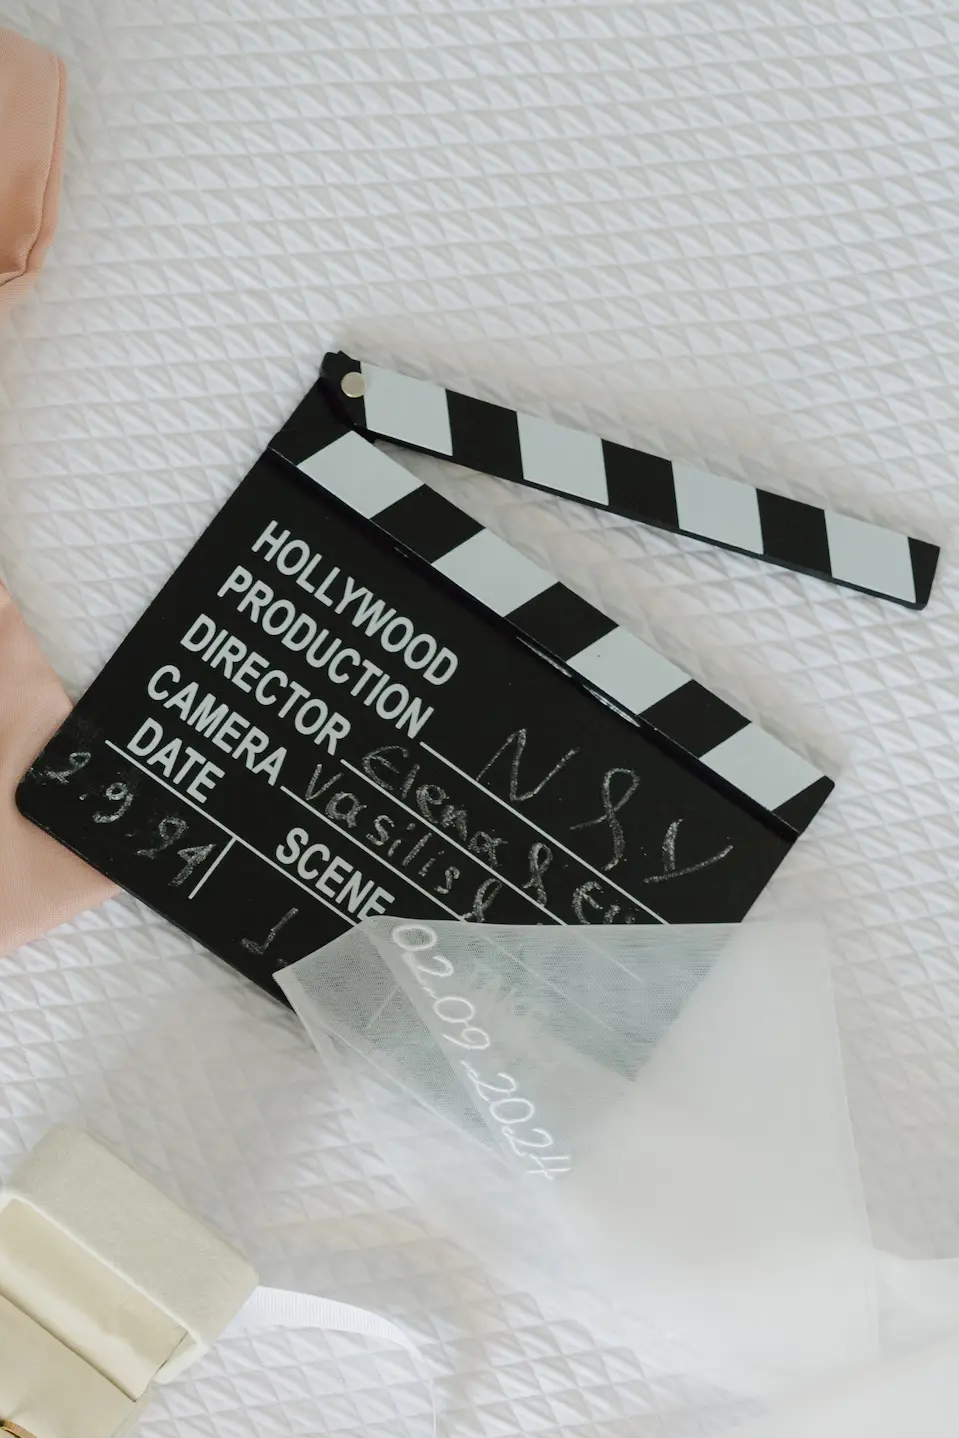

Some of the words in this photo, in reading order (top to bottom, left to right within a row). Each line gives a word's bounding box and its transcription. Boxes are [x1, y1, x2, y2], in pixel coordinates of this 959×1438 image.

[217, 565, 434, 739] PRODUCTION
[251, 520, 459, 686] HOLLYWOOD
[147, 665, 287, 786] CAMERA
[180, 613, 351, 756] DIRECTOR
[126, 717, 225, 803] DATE
[362, 745, 509, 868] Elena
[476, 728, 580, 801] N
[275, 826, 395, 921] SCENE
[392, 924, 571, 1180] 02.09.2024
